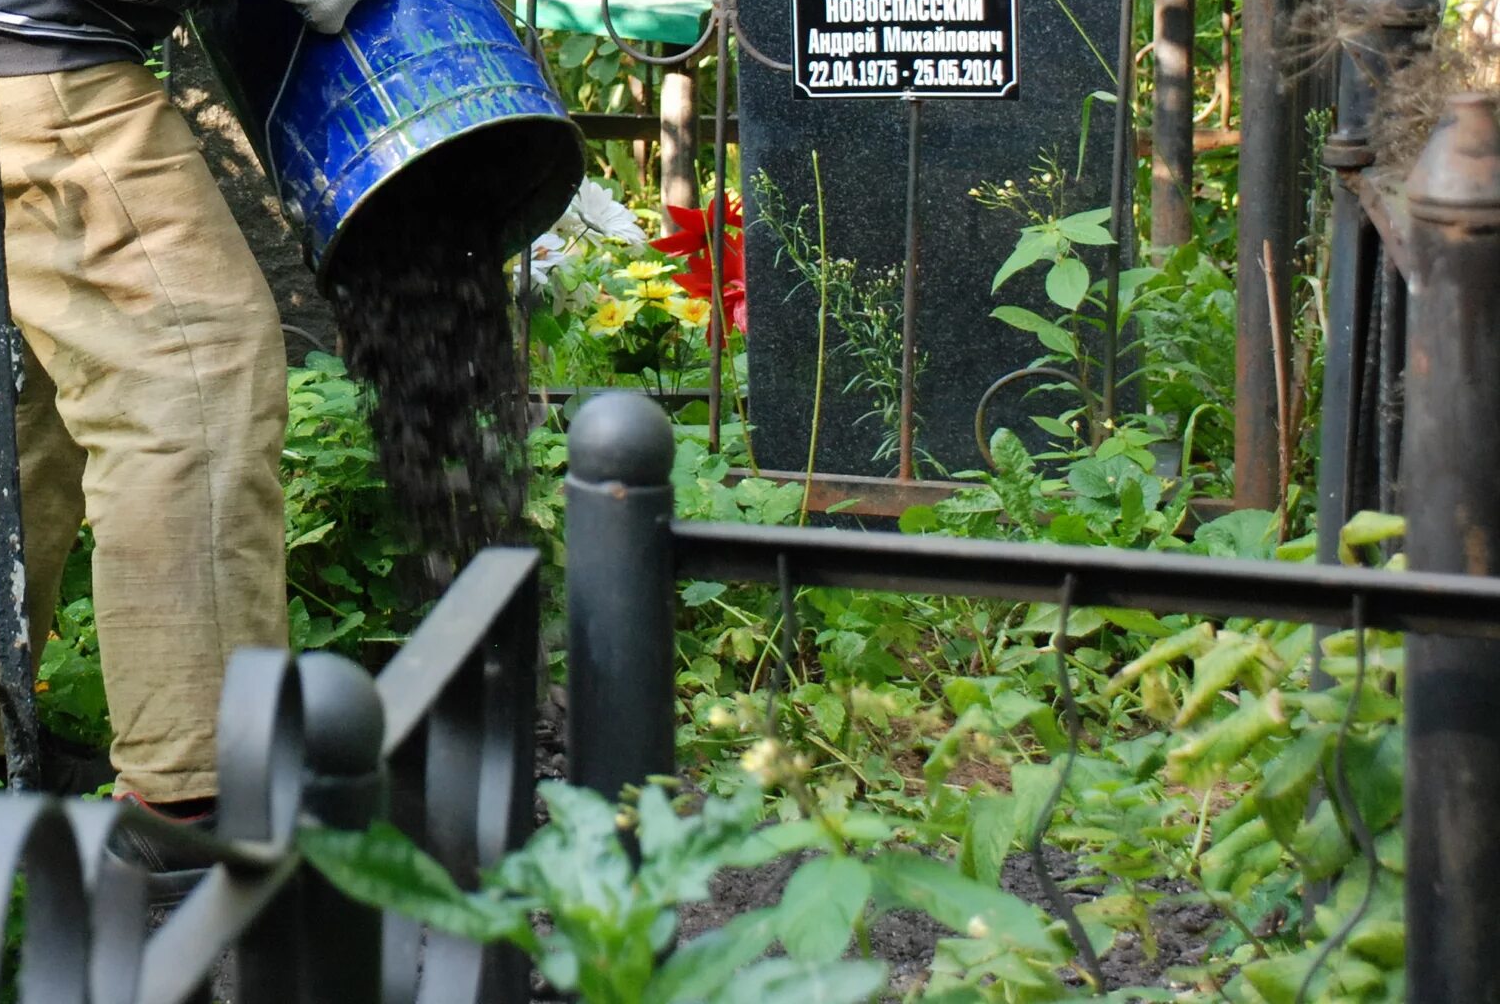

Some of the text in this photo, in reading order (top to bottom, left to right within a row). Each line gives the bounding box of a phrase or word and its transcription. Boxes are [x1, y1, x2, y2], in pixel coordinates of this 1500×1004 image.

[808, 25, 1004, 57] Андрей Михайлович
[809, 59, 898, 87] 22.04.1975
[913, 58, 1004, 86] 25.05.2014
